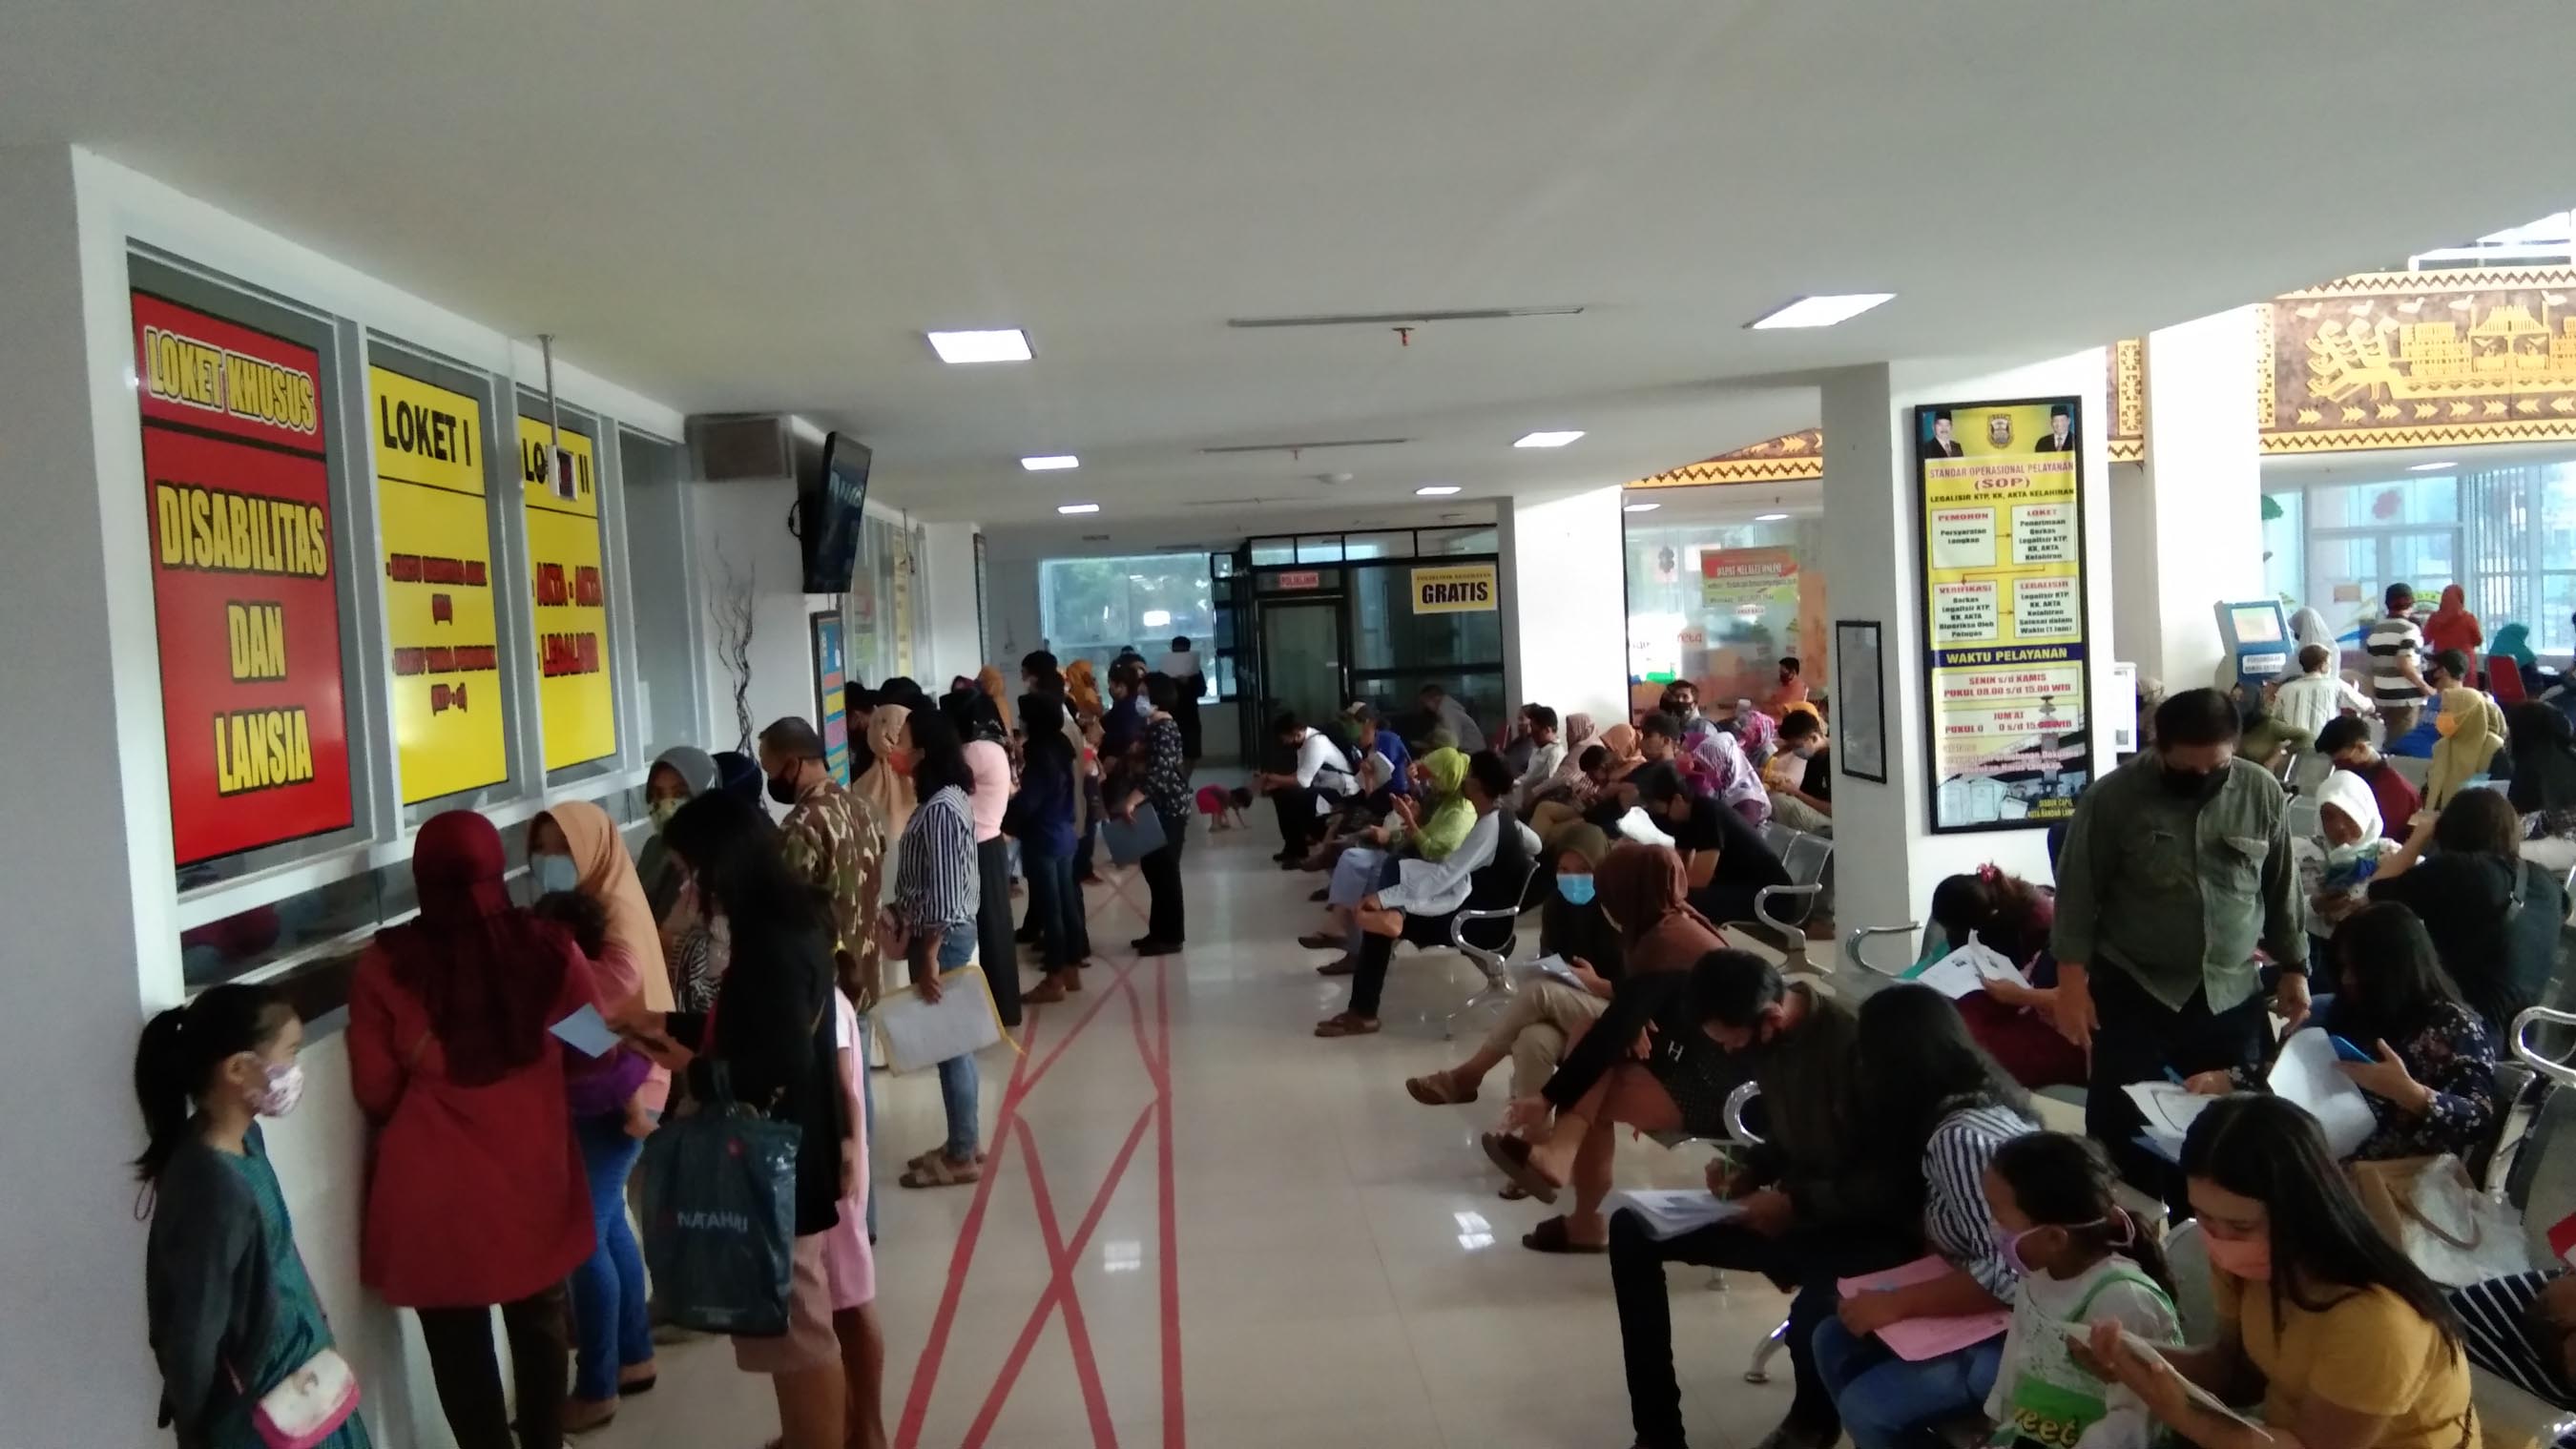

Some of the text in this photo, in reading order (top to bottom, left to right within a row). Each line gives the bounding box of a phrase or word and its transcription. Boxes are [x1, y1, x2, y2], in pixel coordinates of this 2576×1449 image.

[145, 327, 317, 433] LOKET KHUSUS
[381, 396, 456, 464] LOKET
[1930, 462, 2073, 478] STANDAR OPERASIONAL PELAYANAN
[1930, 494, 1972, 503] LEGALISIR
[2029, 488, 2074, 497] KELAHIRAN
[1974, 478, 2030, 490] (SOP)
[156, 484, 327, 577] DISABILITAS
[1422, 581, 1488, 604] GRATIS
[227, 604, 286, 679] DAN
[1946, 648, 2067, 665] WAKTU PELAYANAN
[1968, 676, 1996, 685] SENIN
[2016, 673, 2046, 683] KAMIS
[216, 709, 315, 795] LANSIA
